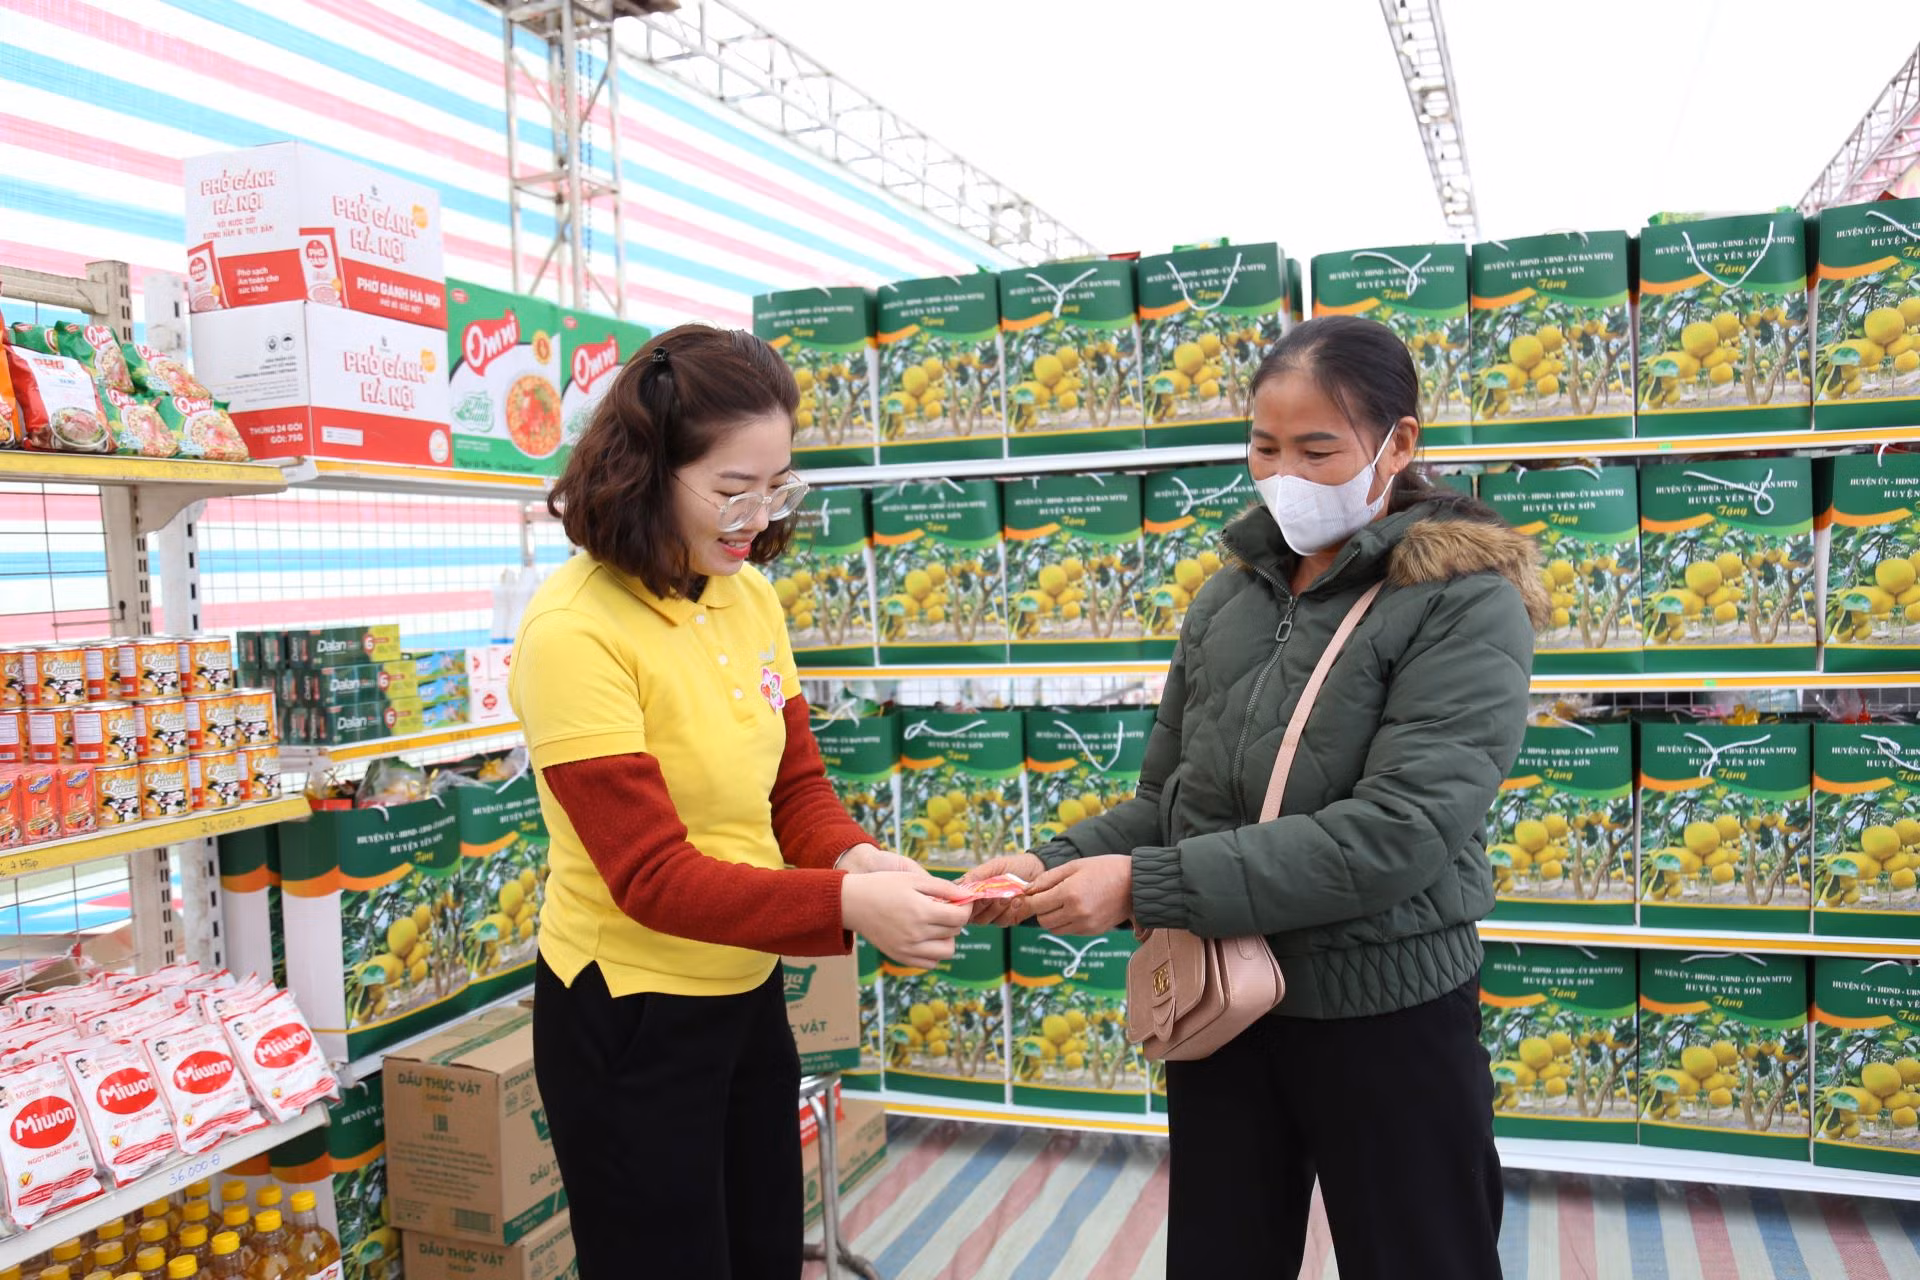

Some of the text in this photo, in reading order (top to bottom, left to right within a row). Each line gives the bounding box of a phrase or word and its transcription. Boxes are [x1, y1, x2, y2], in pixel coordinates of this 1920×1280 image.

[201, 169, 276, 196] PHỞ GÁNH
[213, 192, 264, 215] HÀ NỘI
[333, 194, 417, 238] PHỞ GÁNH
[1836, 225, 1876, 238] HUYỆN ỦY
[350, 226, 406, 264] HÀ NỘI
[1655, 244, 1680, 255] HUYỆN
[1722, 238, 1744, 247] UBND
[1776, 236, 1795, 244] MTTQ
[1872, 235, 1908, 247] HUYỆN
[1724, 250, 1743, 260] YÊN
[1512, 265, 1584, 280] HUYỆN YÊN SƠN
[1714, 262, 1746, 274] Tặng
[356, 274, 379, 294] PHỞ
[380, 281, 408, 299] GÁNH
[410, 286, 424, 304] HÀ
[1538, 278, 1567, 290] Tặng
[344, 345, 427, 384] PHỞ GÁNH
[361, 377, 416, 412] HÀ NỘI
[1656, 484, 1680, 494] HUYỆN
[1682, 484, 1692, 492] ỦY
[1776, 480, 1798, 488] MTTQ
[1850, 476, 1889, 488] HUYỆN ỦY
[1522, 500, 1596, 512] HUYỆN YÊN SƠN
[1688, 494, 1744, 504] HUYỆN YÊN
[1716, 504, 1748, 516] Tặng
[1550, 512, 1578, 525] Tặng
[316, 638, 347, 652] Dalan
[364, 636, 373, 650] 6
[330, 678, 358, 692] Dalan
[380, 674, 388, 688] 6
[338, 716, 367, 730] Dalan
[387, 710, 394, 724] 6
[1656, 744, 1682, 754] HUYỆN
[1683, 746, 1693, 754] ỦY
[1776, 746, 1796, 754] MTTQ
[1832, 746, 1870, 756] HUYỆN ỦY
[1518, 758, 1590, 768] HUYỆN YÊN SƠN
[1726, 758, 1766, 766] YÊN SƠN
[1545, 768, 1573, 781] Tặng
[1717, 768, 1746, 780] Tặng
[1522, 976, 1594, 986] HUYỆN YÊN SƠN
[1654, 968, 1678, 978] HUYỆN
[1772, 976, 1792, 984] MTTQ
[1549, 986, 1576, 1000] Tặng
[1685, 983, 1762, 995] HUYỆN YÊN SƠN
[1832, 980, 1872, 992] HUYỆN ỦY
[1712, 994, 1744, 1008] Tặng
[1867, 996, 1902, 1008] HUYỆN
[800, 1019, 828, 1036] VẬT
[256, 1030, 311, 1064] Miwon
[176, 1060, 232, 1087] Miwon
[425, 1076, 455, 1092] THỰC
[15, 1106, 75, 1141] Miwon
